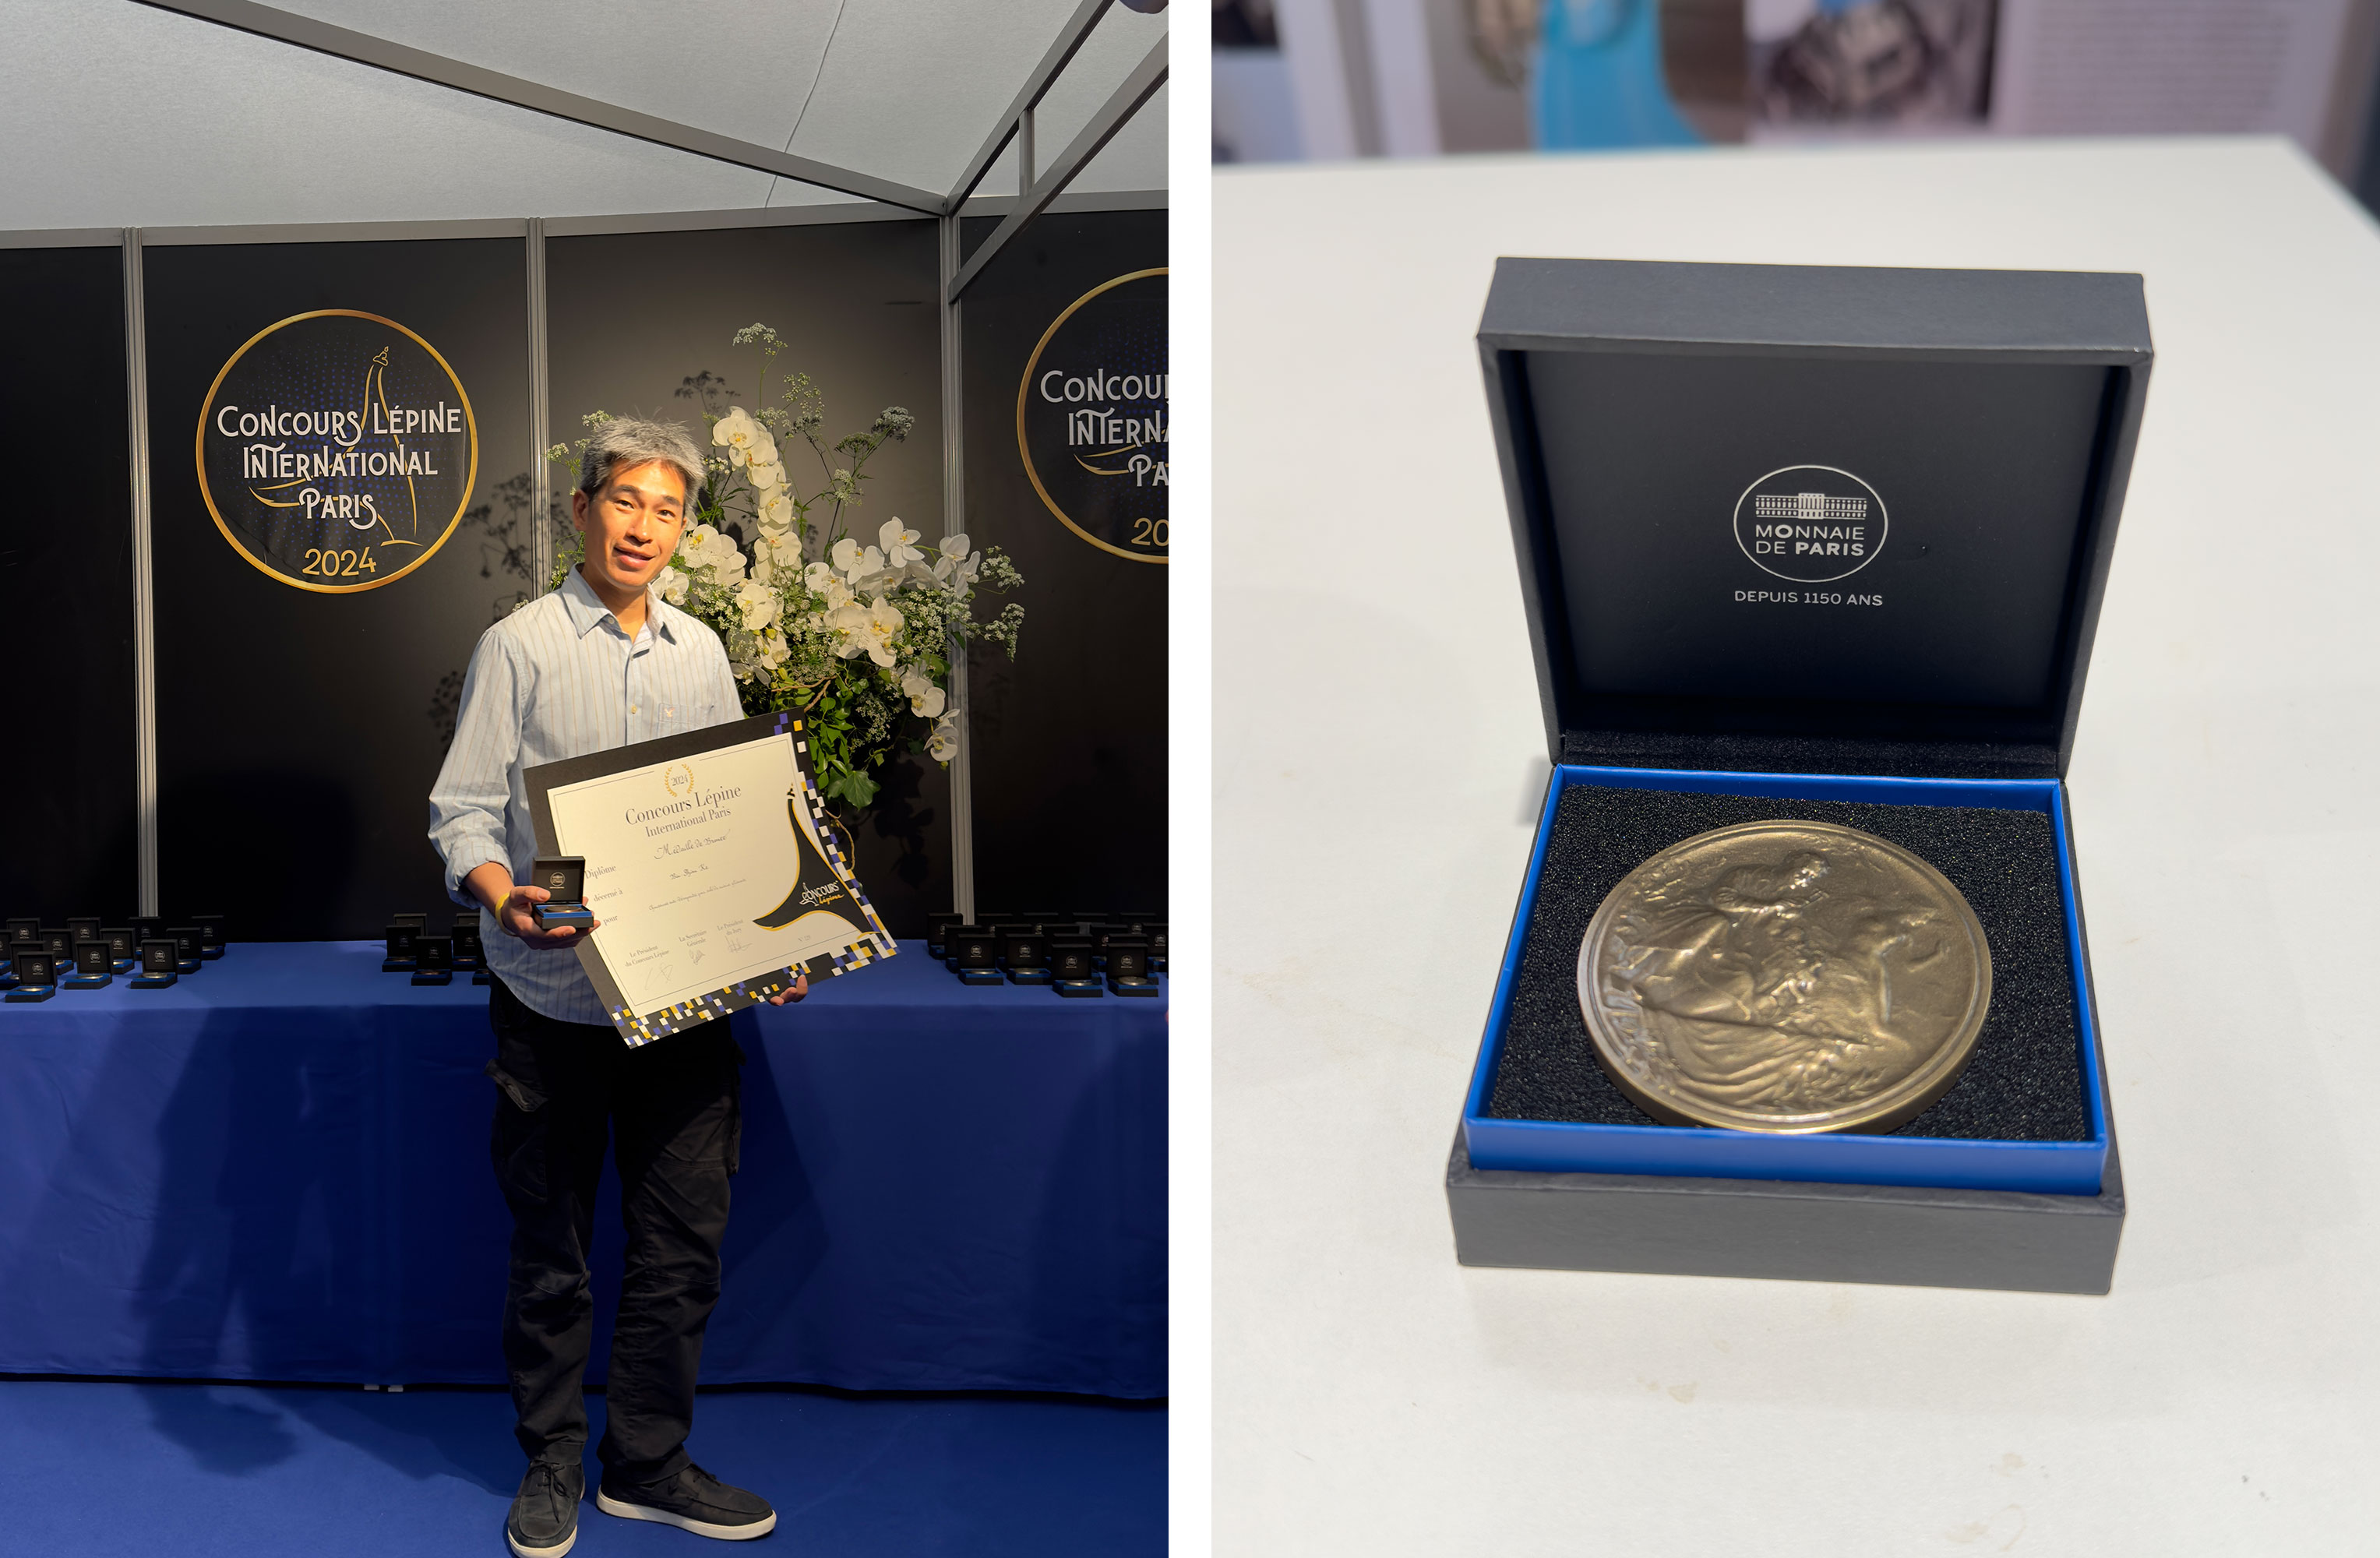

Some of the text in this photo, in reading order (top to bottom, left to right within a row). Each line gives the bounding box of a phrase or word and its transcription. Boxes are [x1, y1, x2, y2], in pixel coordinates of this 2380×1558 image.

[217, 401, 461, 446] CONCOURS LÉPINE
[243, 442, 438, 481] INTERNATIONAL
[299, 488, 378, 530] PARIS
[1755, 524, 1865, 541] MONNAIE
[302, 547, 377, 576] 2024
[1755, 541, 1864, 557] DE PARIS
[1734, 590, 1883, 607] DEPUIS 1150 ANS
[671, 774, 689, 787] 2024
[625, 785, 742, 826] Concours Lépine
[645, 806, 732, 837] International Paris
[584, 865, 616, 879] Diplôme
